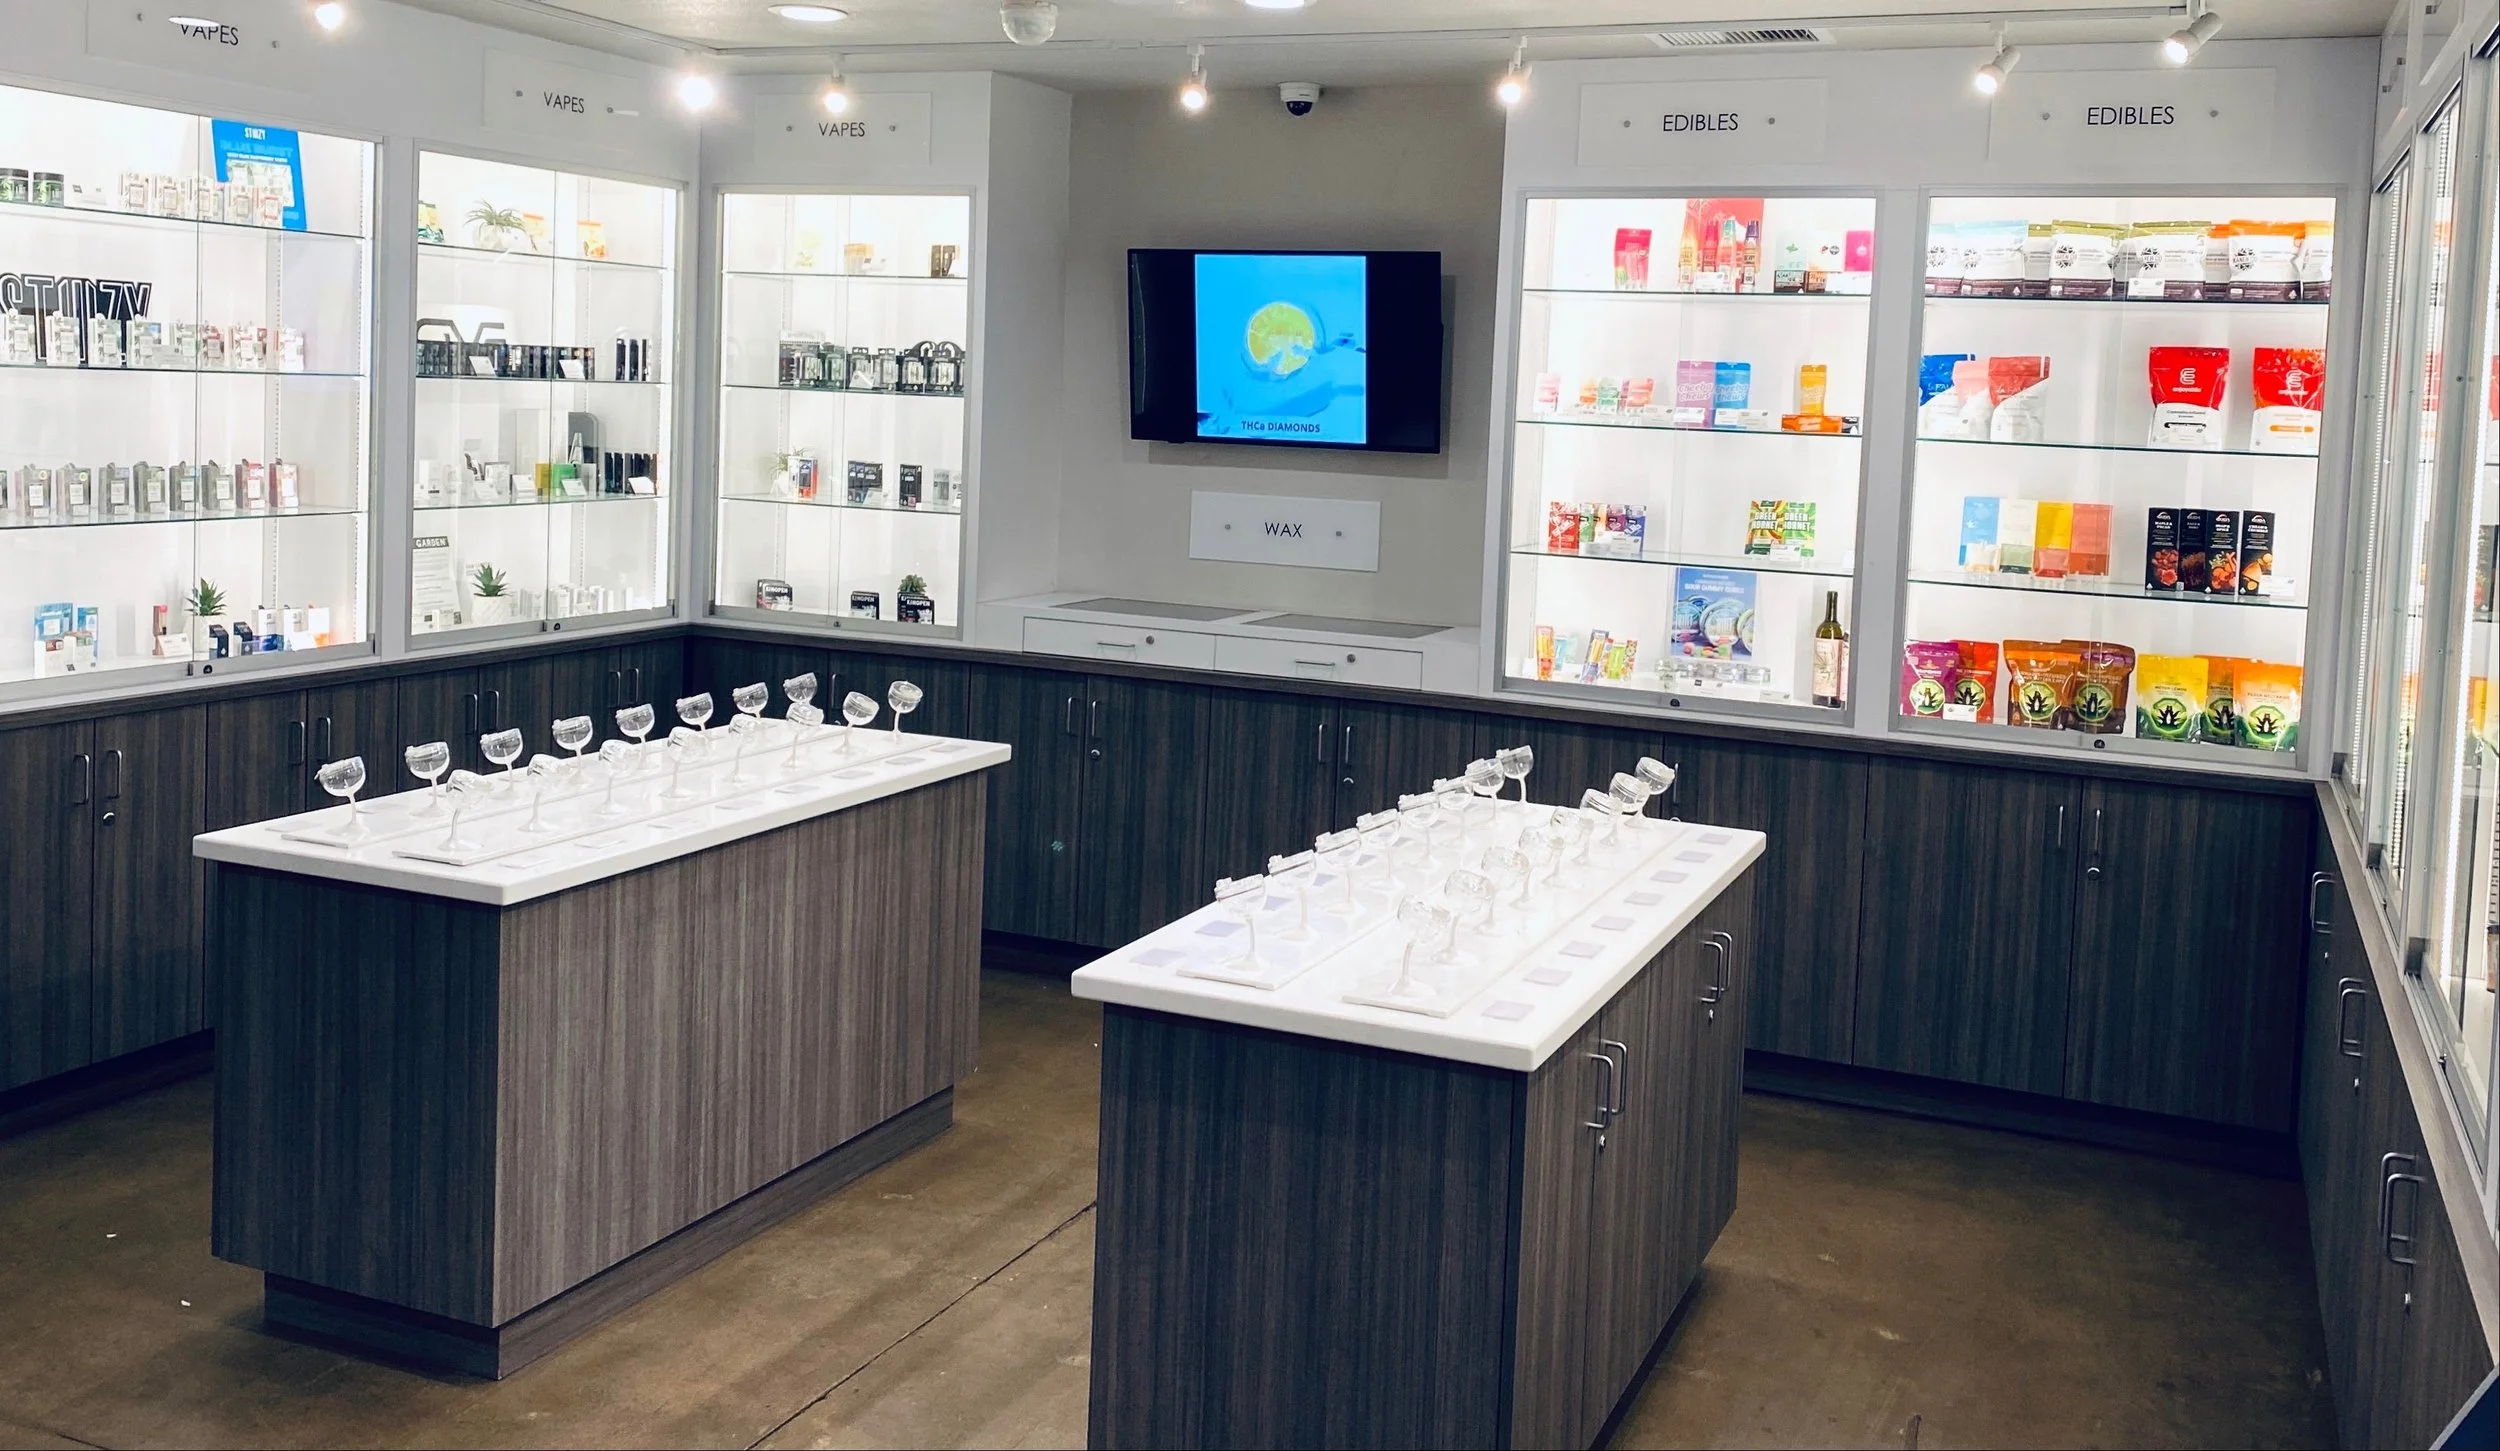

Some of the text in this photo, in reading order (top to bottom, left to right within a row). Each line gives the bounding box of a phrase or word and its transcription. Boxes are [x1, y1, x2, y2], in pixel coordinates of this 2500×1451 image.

[180, 25, 239, 46] VAPES
[543, 92, 585, 114] VAPES
[1663, 113, 1739, 132] EDIBLES
[2087, 106, 2175, 126] EDIBLES
[818, 121, 866, 138] VAPES
[1241, 420, 1321, 434] THCa DIAMONDS
[1264, 521, 1303, 539] WAX
[415, 537, 446, 548] GARDEN
